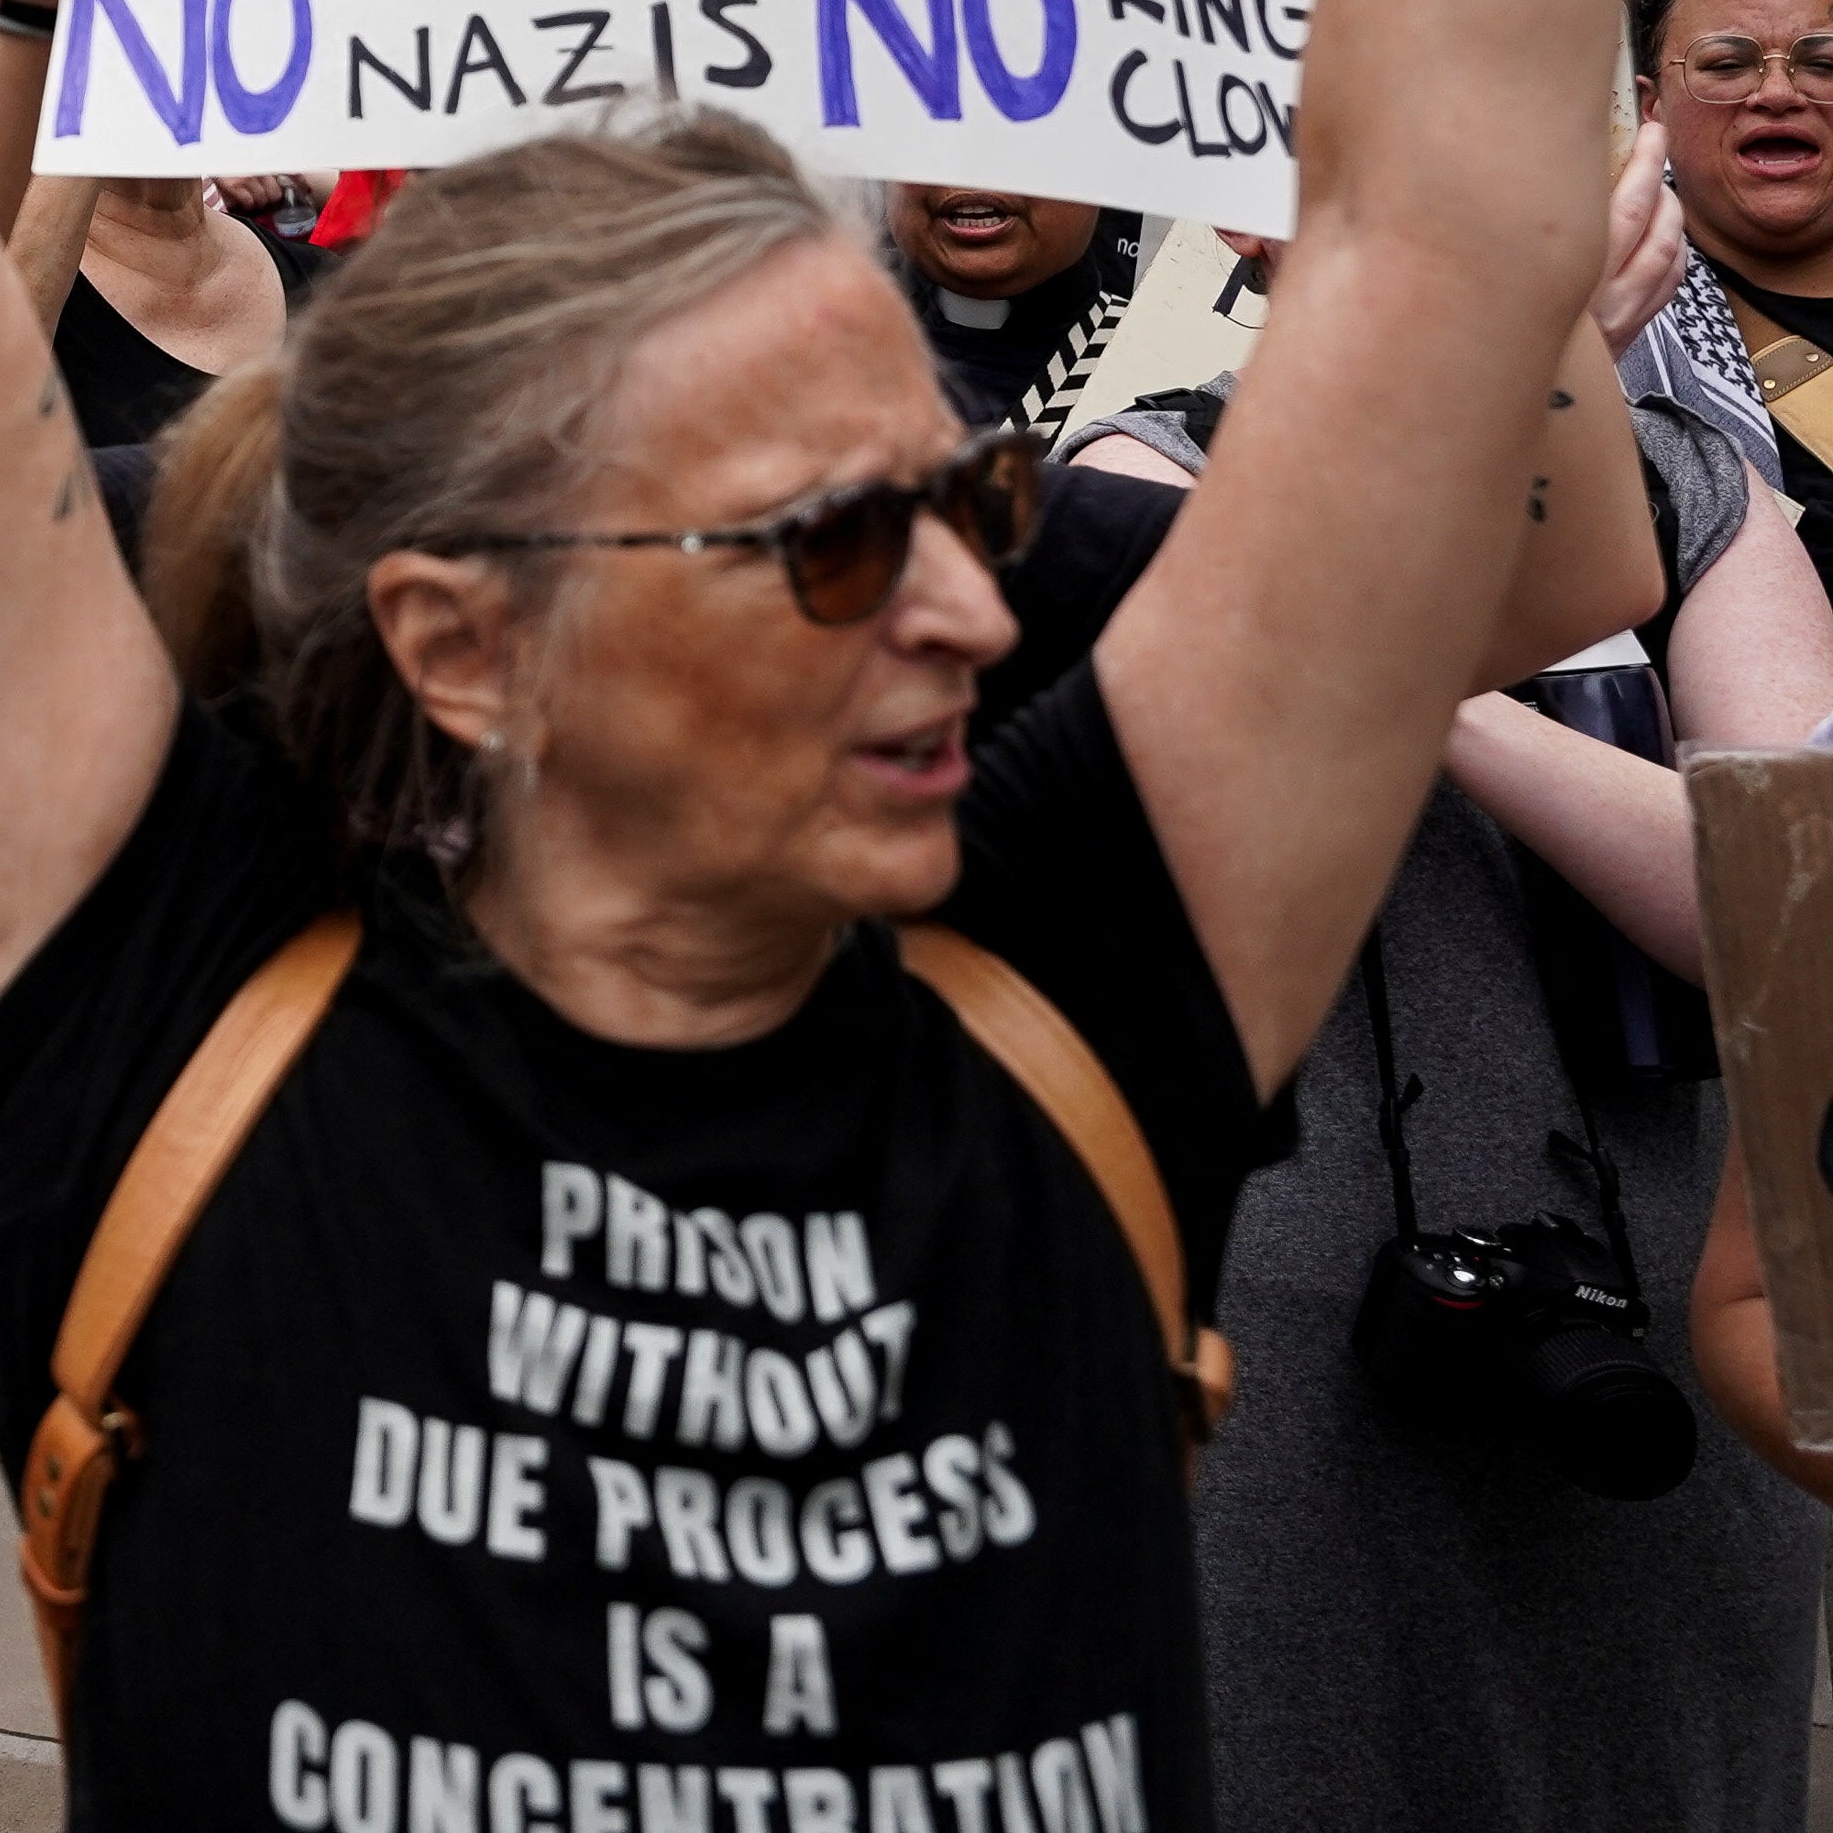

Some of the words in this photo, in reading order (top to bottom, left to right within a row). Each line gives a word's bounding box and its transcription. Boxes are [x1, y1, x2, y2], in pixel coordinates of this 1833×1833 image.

[541, 1160, 877, 1324] PRISON
[1574, 1284, 1629, 1309] Nikon
[487, 1279, 917, 1458] WITHOUT
[349, 1395, 549, 1562] DUE
[588, 1420, 1037, 1587] PROCESS
[606, 1600, 713, 1733] IS
[762, 1612, 839, 1737] A
